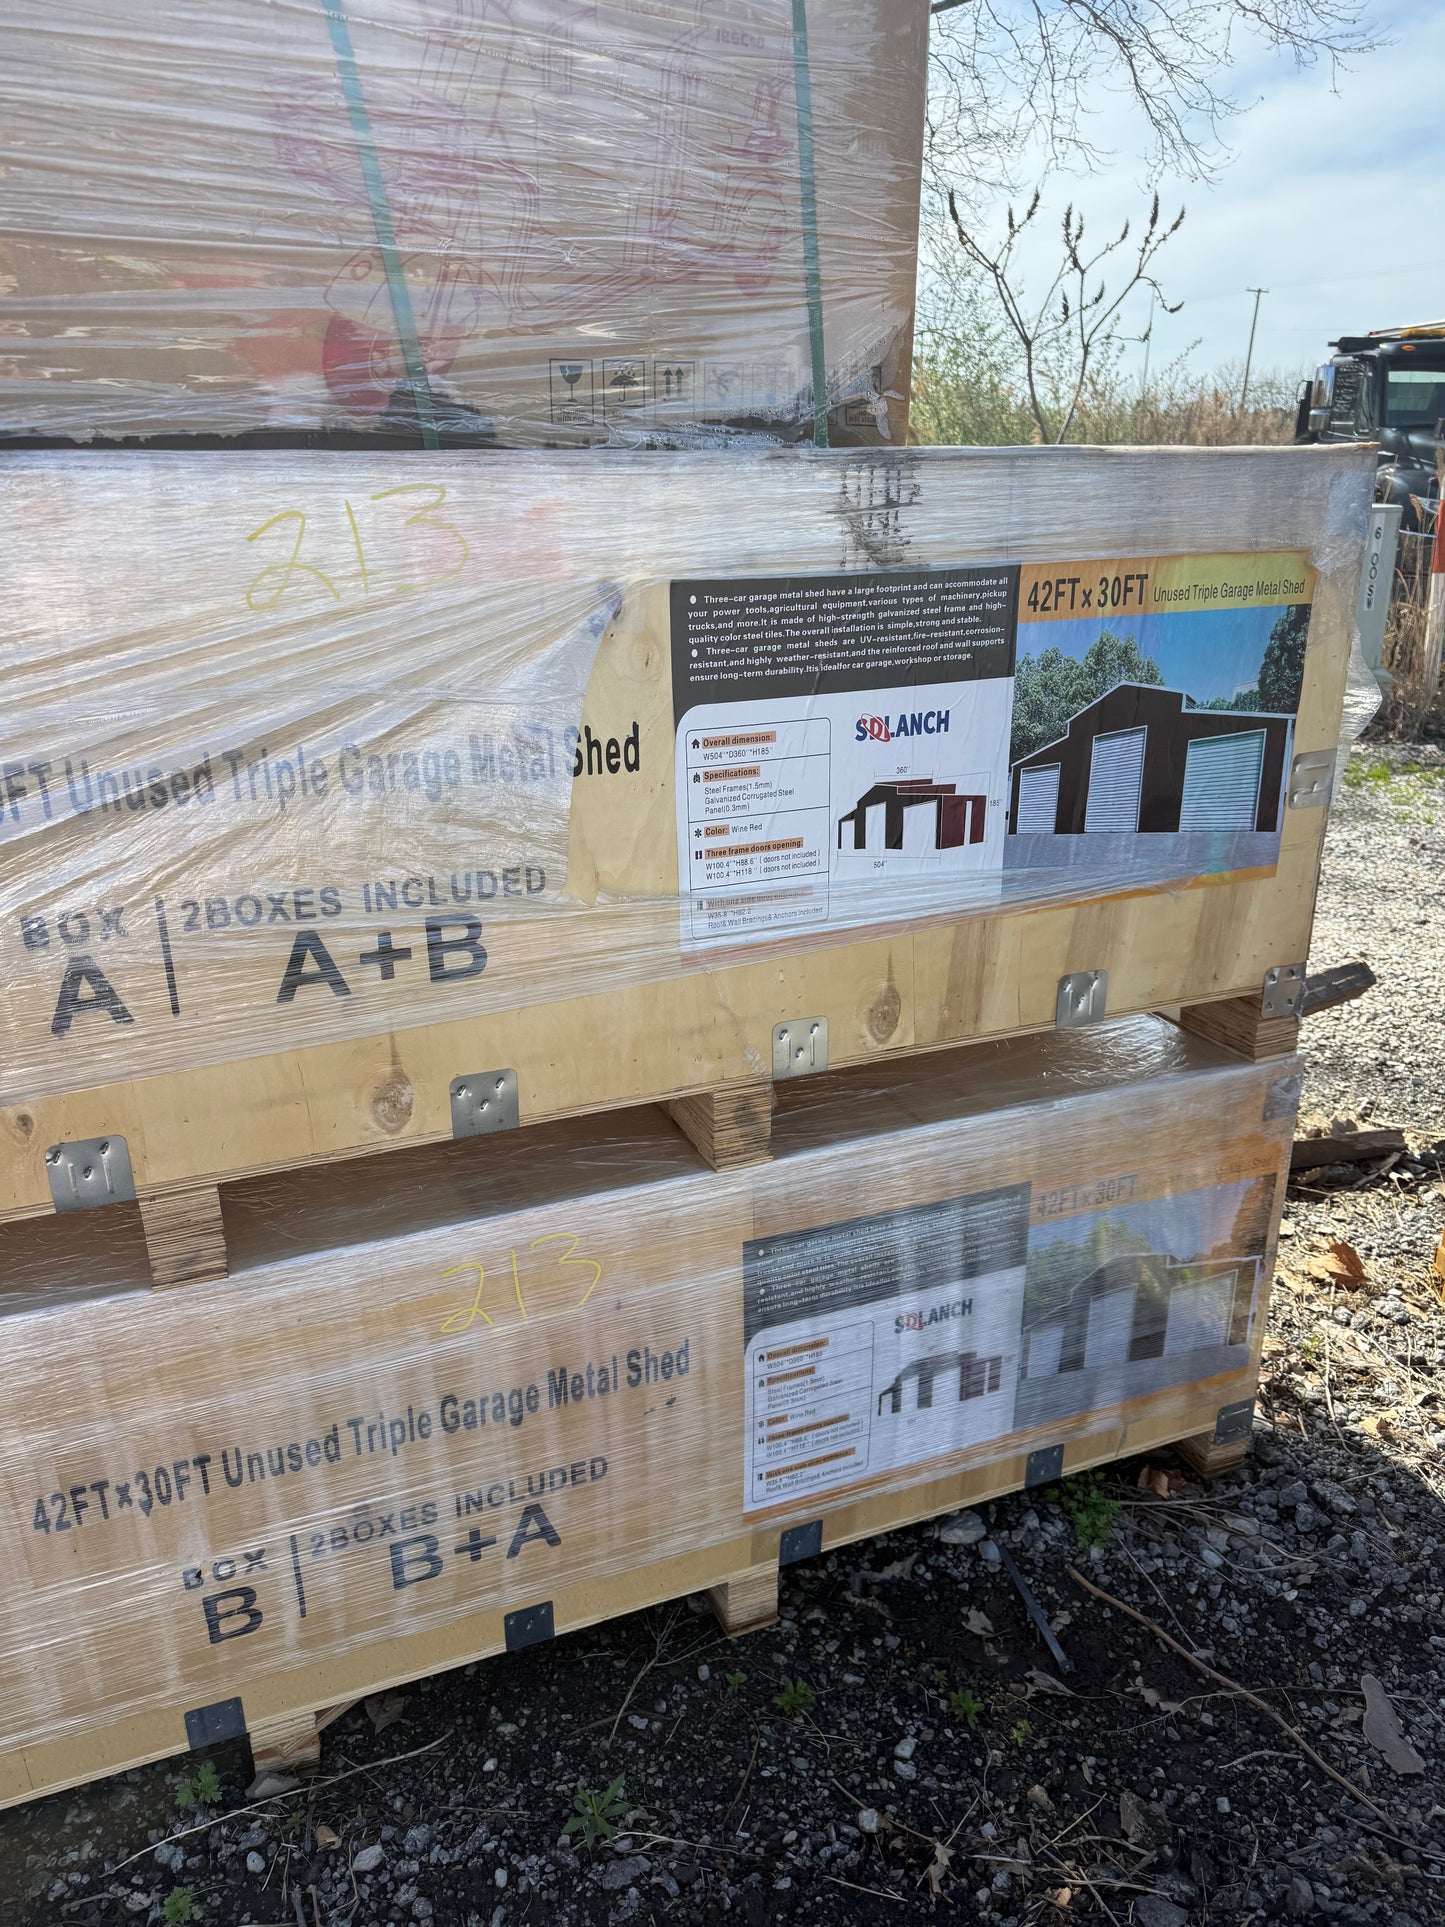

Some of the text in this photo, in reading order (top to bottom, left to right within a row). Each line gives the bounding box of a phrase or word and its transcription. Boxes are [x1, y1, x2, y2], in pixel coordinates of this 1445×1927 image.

[247, 483, 469, 610] 213
[688, 611, 708, 619] your
[713, 609, 740, 617] power
[745, 602, 817, 615] tools,agricultural
[822, 598, 897, 609] equipment,various
[902, 596, 923, 604] types
[941, 590, 1007, 600] machinery,pickup
[704, 595, 746, 604] Three-car
[749, 593, 777, 602] garage
[805, 589, 824, 597] shed
[855, 587, 874, 595] large
[876, 584, 911, 593] footprint
[945, 579, 996, 588] accommodate
[999, 577, 1008, 585] all
[1028, 578, 1080, 612] 42FT
[1098, 574, 1148, 608] 30FT
[1154, 586, 1190, 602] Unused
[1193, 584, 1218, 604] Triple
[1221, 582, 1253, 600] Garage
[1256, 580, 1281, 596] Metal
[1283, 578, 1305, 595] Shed
[688, 620, 733, 631] trucks,and
[737, 619, 766, 628] more.It
[781, 616, 803, 625] made
[819, 611, 874, 623] high-strength
[878, 608, 920, 619] galvanized
[944, 605, 966, 613] frame
[986, 602, 1006, 610] high-
[689, 635, 718, 645] quality
[720, 633, 741, 642] color
[743, 631, 763, 640] steel
[765, 629, 800, 638] tiles.The
[802, 627, 829, 636] overall
[831, 624, 875, 634] installation
[887, 619, 940, 630] simple,strong
[941, 617, 955, 625] and
[690, 658, 744, 669] resistant,and
[746, 657, 772, 666] highly
[776, 649, 866, 663] weather-resistant,and
[868, 647, 880, 655] the
[882, 644, 920, 654] reinforced
[955, 640, 970, 648] wall
[972, 638, 1004, 647] supports
[706, 646, 748, 655] Three-car
[753, 645, 782, 653] garage
[787, 641, 810, 649] metal
[815, 639, 837, 647] sheds
[690, 674, 718, 682] ensure
[720, 670, 763, 680] long-term
[866, 655, 931, 669] garage,workshop
[703, 734, 773, 747] Overall dimension:
[0, 721, 640, 824] FT Unused Triple Garage Metal Shed
[704, 768, 759, 780] Specifications:
[704, 781, 772, 794] Steel Frames(1.5mm)
[705, 788, 794, 804] Galvanized Corrugated Steel
[705, 823, 762, 836] Color: Wine Red
[706, 840, 803, 857] Three frame doors opening:
[764, 854, 780, 863] doors
[792, 850, 816, 858] included
[764, 864, 780, 873] doors
[792, 859, 816, 868] included
[20, 904, 128, 952] BOX
[364, 866, 548, 913] INCLUDED
[50, 956, 135, 1035] A
[440, 1233, 602, 1334] 213
[222, 1425, 341, 1490] Unused
[348, 1407, 433, 1456] Triple
[439, 1384, 541, 1434] Garage
[546, 1356, 619, 1410] Metal
[626, 1338, 691, 1390] Shed
[182, 1548, 268, 1591] BOX
[454, 1456, 609, 1520] INCLUDED
[202, 1586, 264, 1646] B
